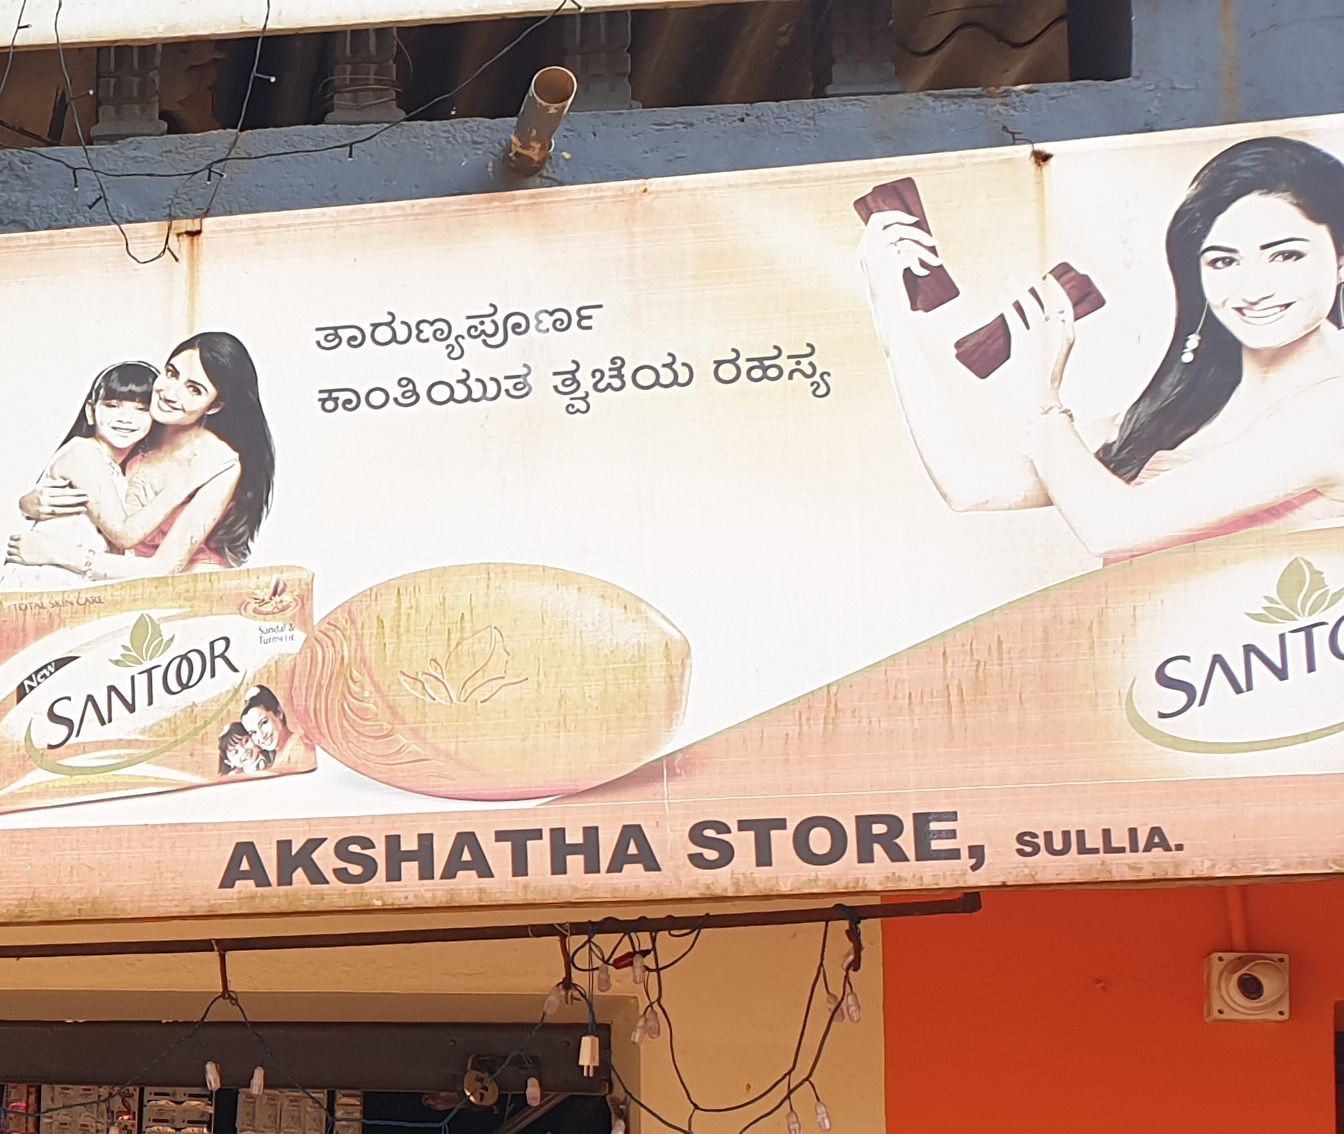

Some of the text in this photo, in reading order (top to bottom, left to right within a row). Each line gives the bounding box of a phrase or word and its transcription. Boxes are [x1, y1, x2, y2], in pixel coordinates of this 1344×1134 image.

[317, 341, 832, 416] ಕಾಂತಿಯುತ ತ್ವಚೆಯ ರಹಸ್ಯ
[75, 594, 105, 609] CARE
[47, 635, 240, 750] SANTOOR
[218, 810, 1185, 890] AKSHATHA STORE, SULLIA.
